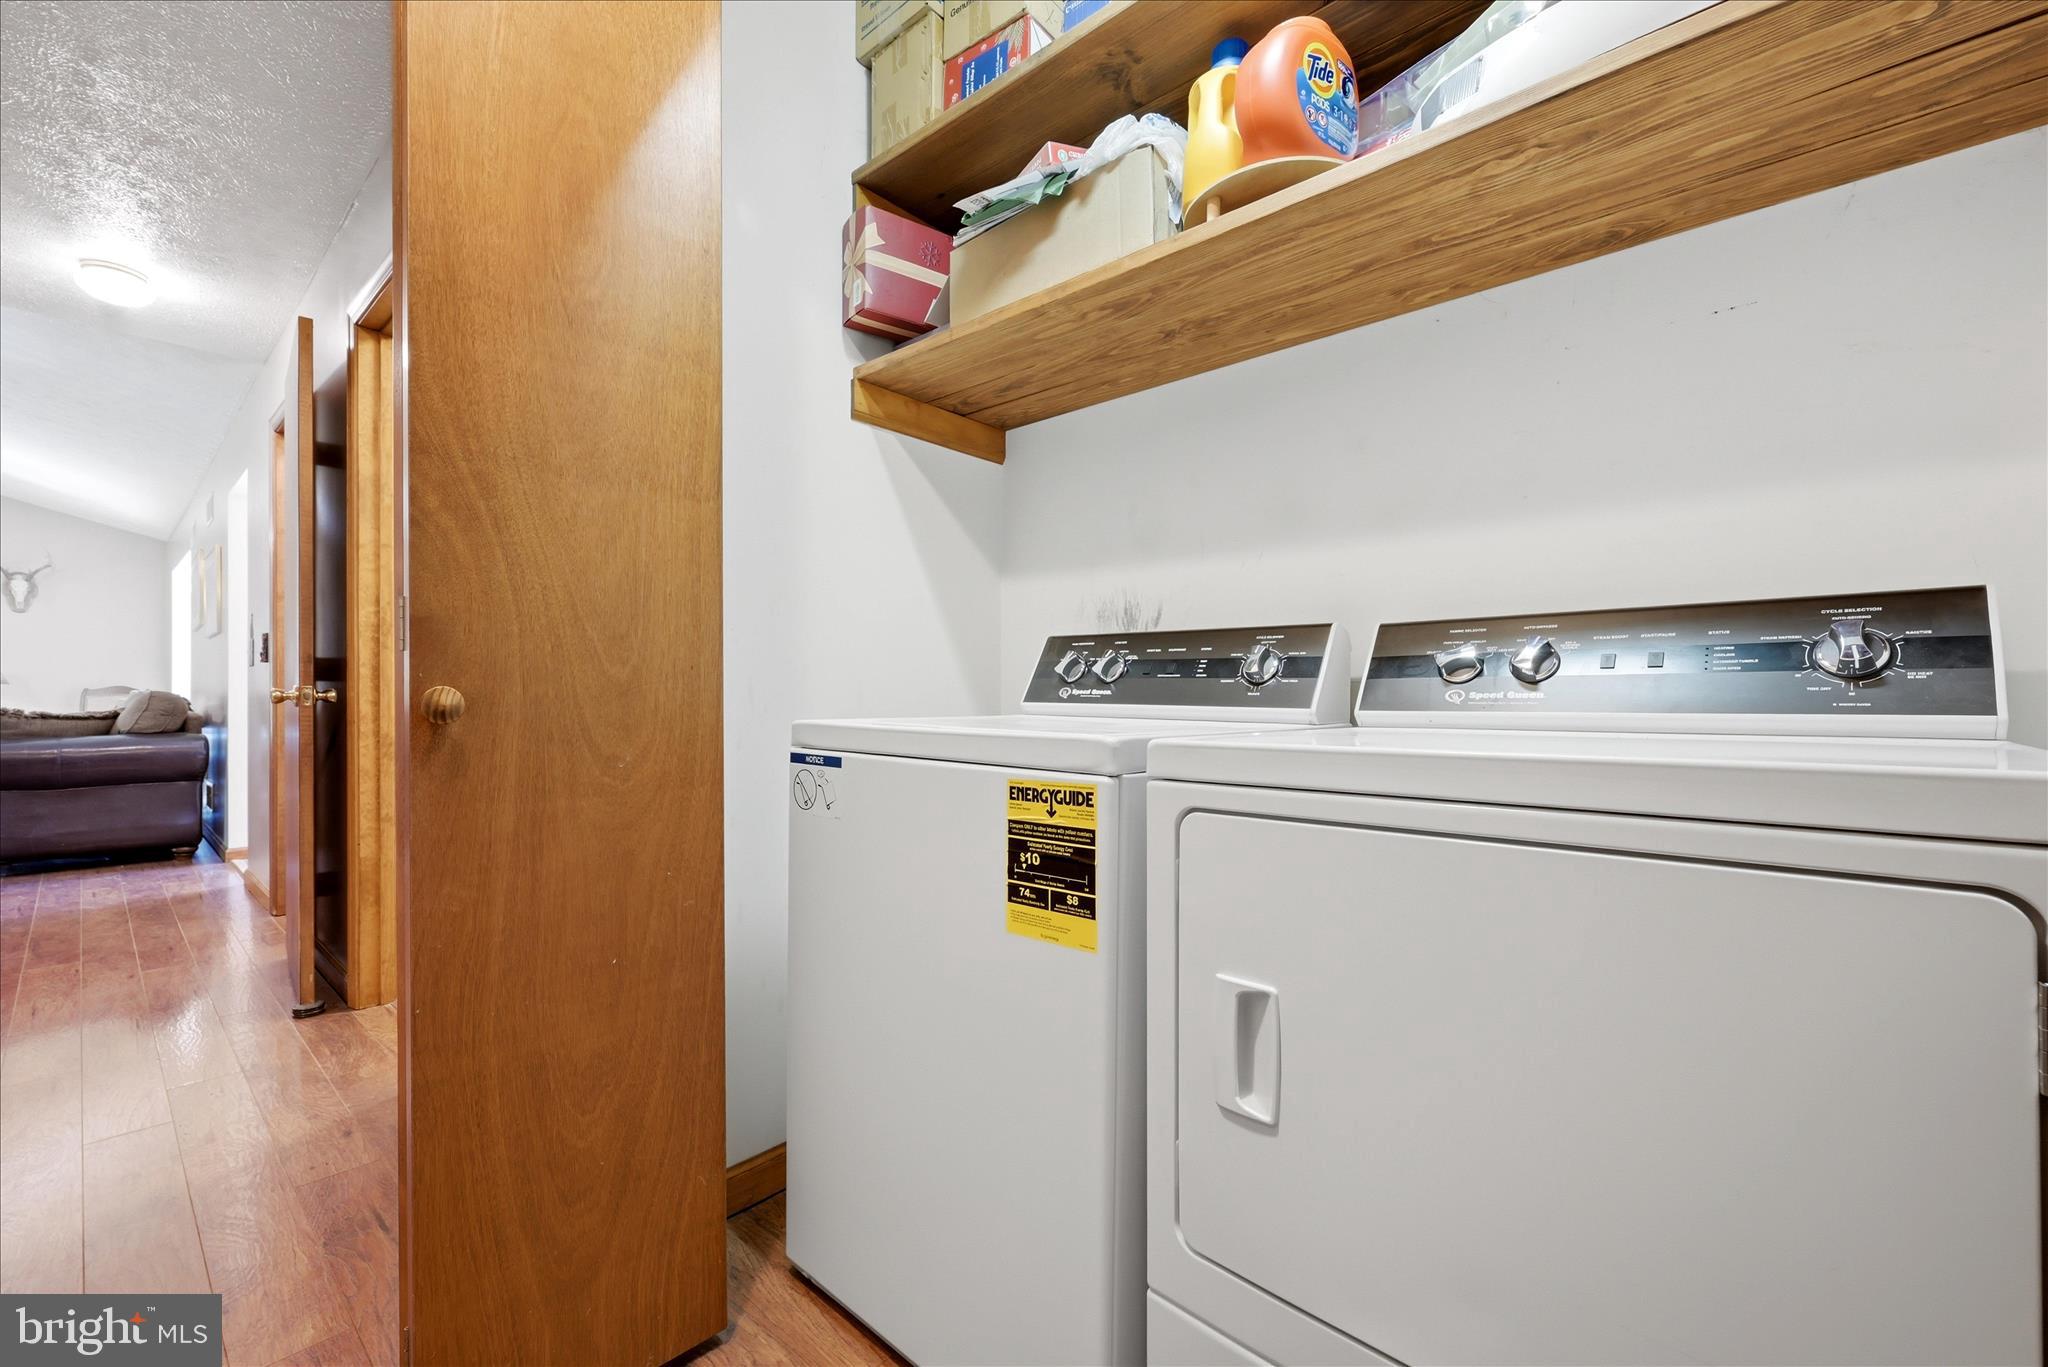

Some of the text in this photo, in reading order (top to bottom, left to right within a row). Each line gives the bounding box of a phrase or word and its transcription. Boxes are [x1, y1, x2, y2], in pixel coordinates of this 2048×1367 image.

[950, 0, 976, 17] Genui
[1307, 53, 1335, 84] Tide
[1311, 93, 1331, 112] PODS
[1468, 691, 1545, 700] Speed Queen
[1009, 786, 1094, 808] ENERGYGUIDE
[1020, 852, 1040, 865] $10
[1019, 887, 1030, 898] 74
[1066, 895, 1079, 906] $8
